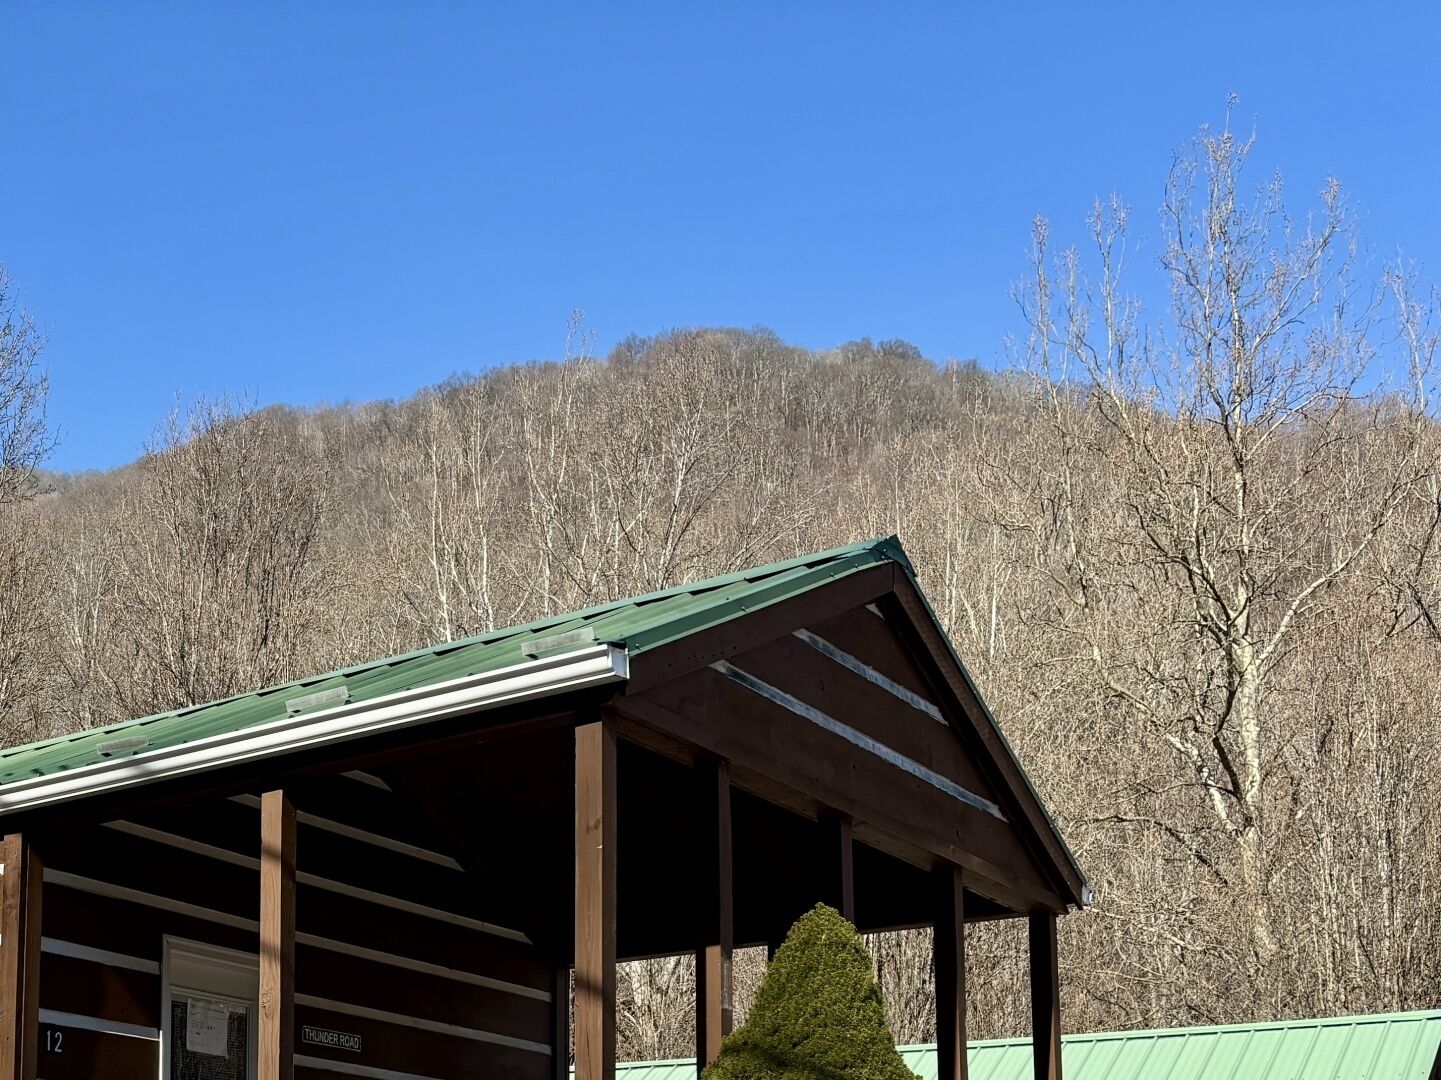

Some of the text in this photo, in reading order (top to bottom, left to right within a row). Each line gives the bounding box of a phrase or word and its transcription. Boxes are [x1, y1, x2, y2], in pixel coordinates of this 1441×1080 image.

[47, 1030, 62, 1052] 12
[304, 1028, 359, 1048] THUNDER ROAD
